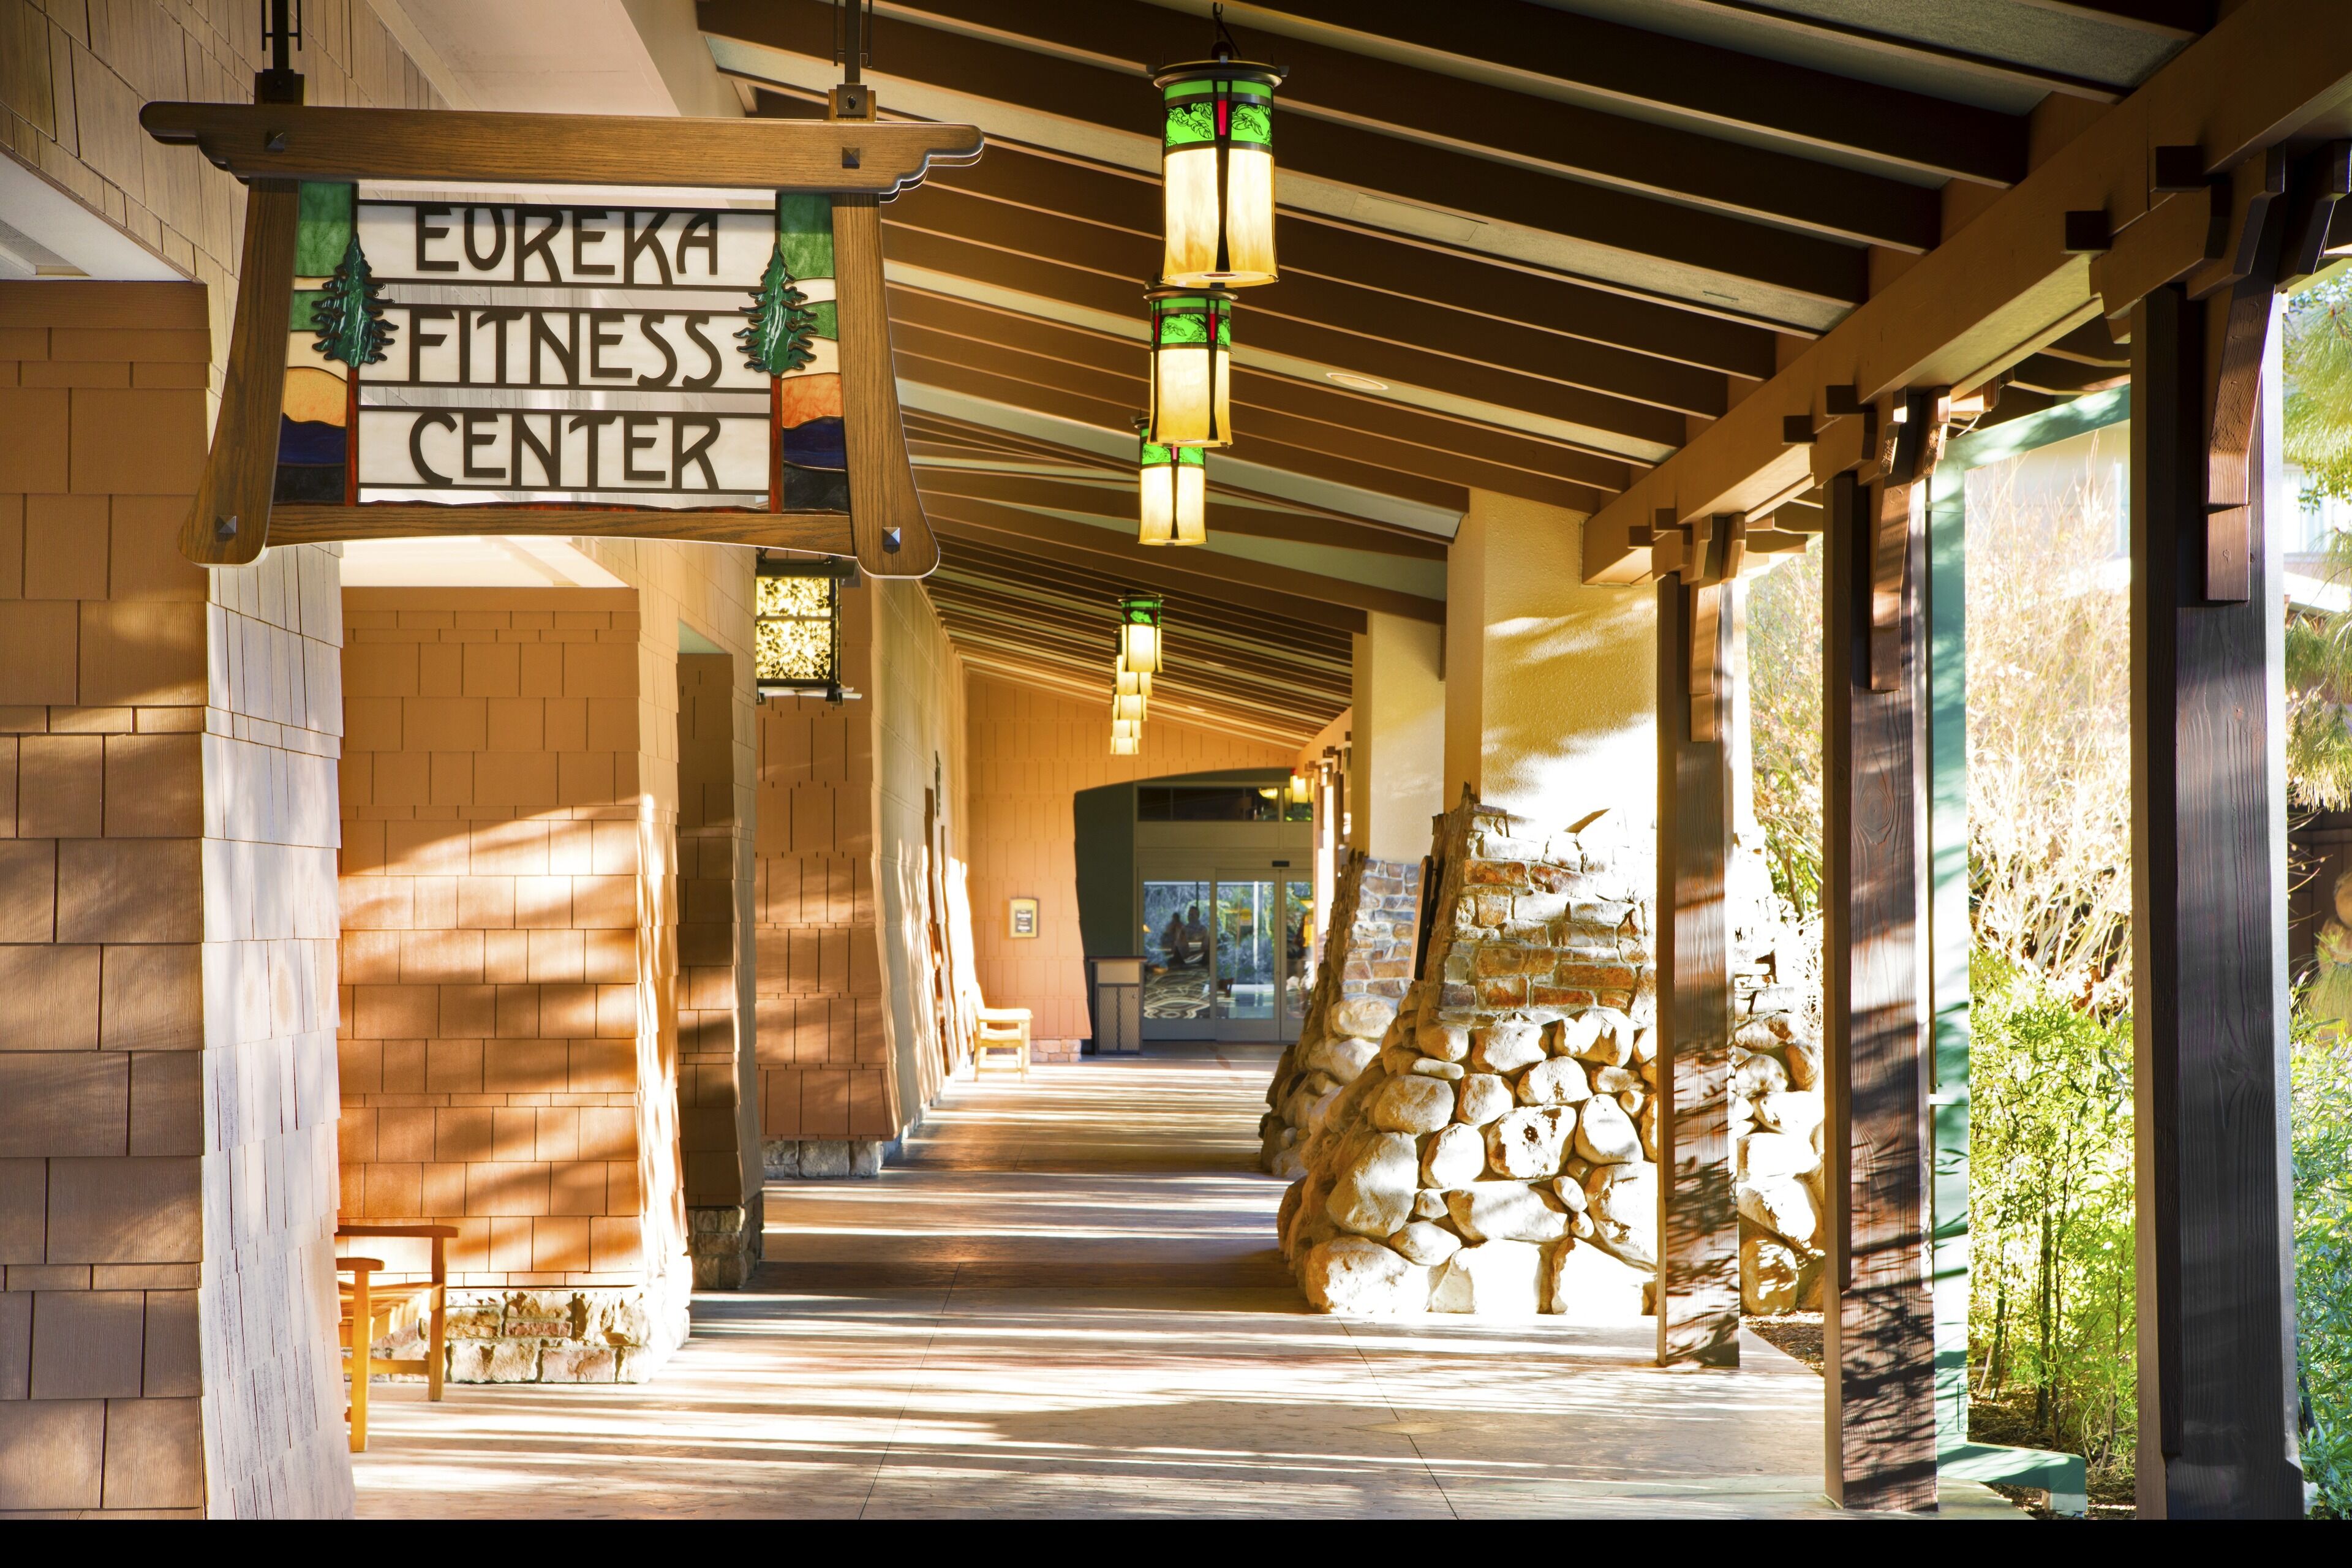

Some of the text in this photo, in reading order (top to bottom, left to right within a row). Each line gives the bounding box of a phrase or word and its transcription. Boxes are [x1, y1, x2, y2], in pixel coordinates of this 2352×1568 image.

[416, 205, 718, 285] EUREKA
[409, 308, 722, 388] FITNESS
[409, 411, 721, 490] CENTER
